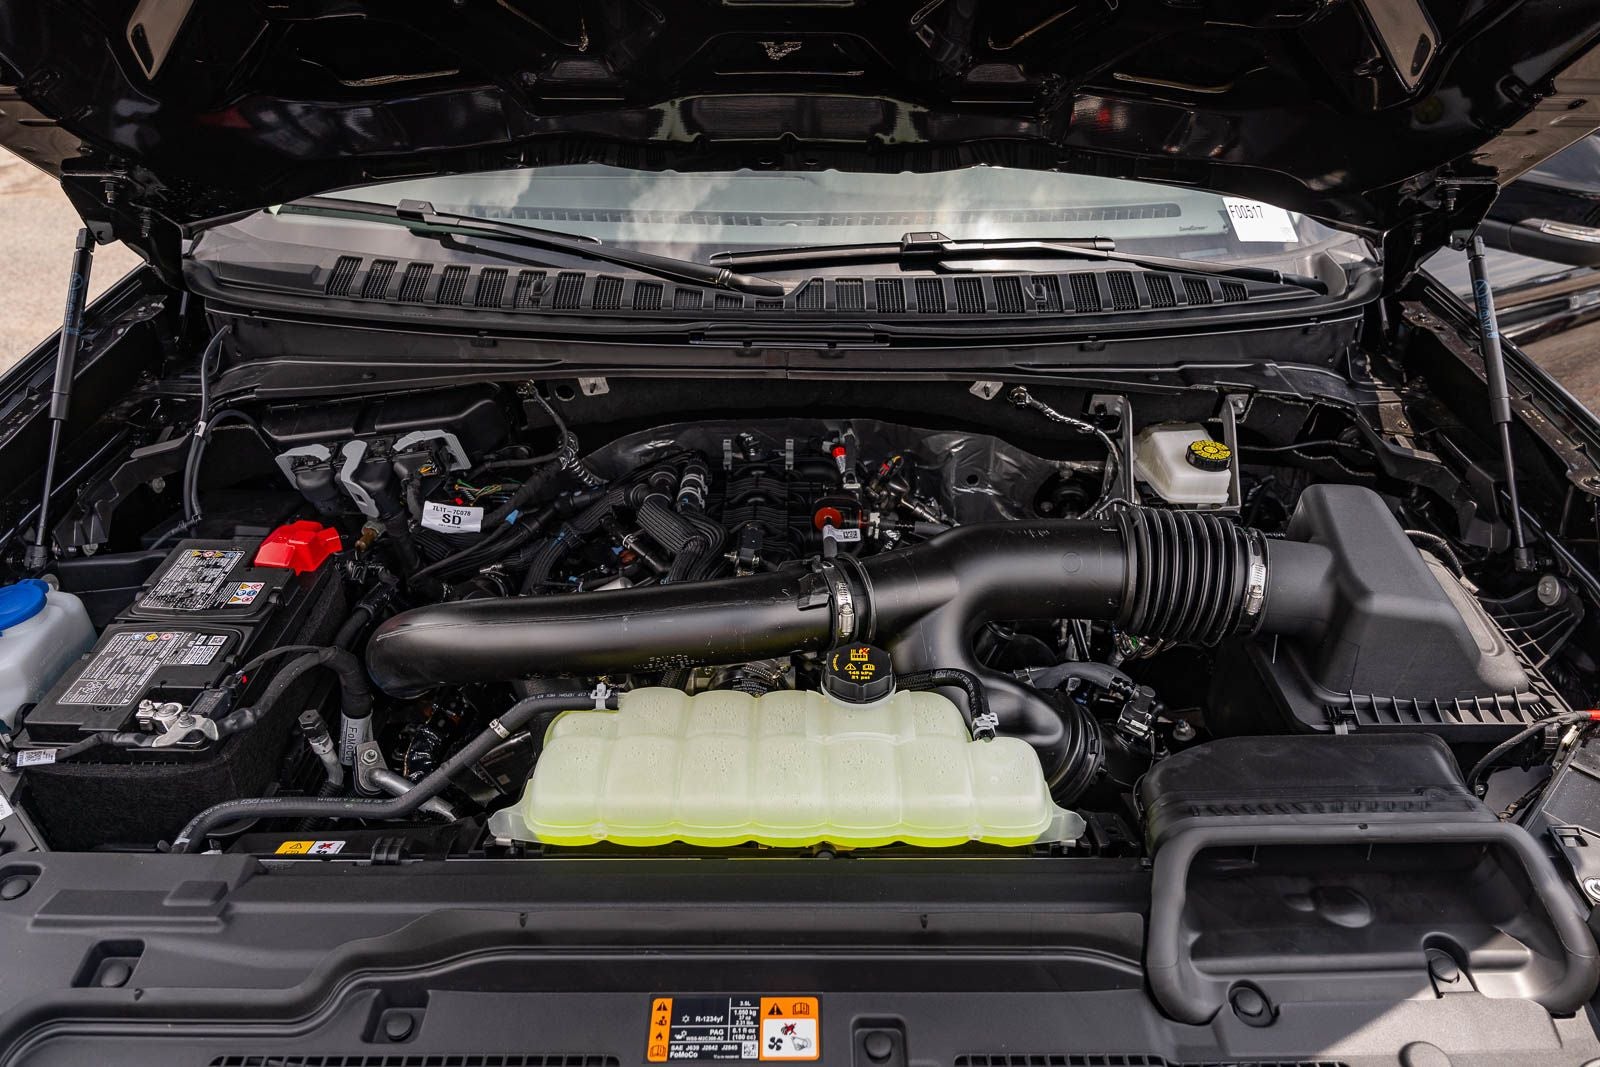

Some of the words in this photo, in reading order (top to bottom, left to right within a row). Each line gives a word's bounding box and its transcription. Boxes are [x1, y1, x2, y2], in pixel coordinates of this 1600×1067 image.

[1228, 205, 1263, 218] F00517
[442, 513, 461, 525] SD
[749, 1009, 757, 1017] kg
[695, 1015, 724, 1024] R-1234yf
[669, 1050, 699, 1058] FoMoCo
